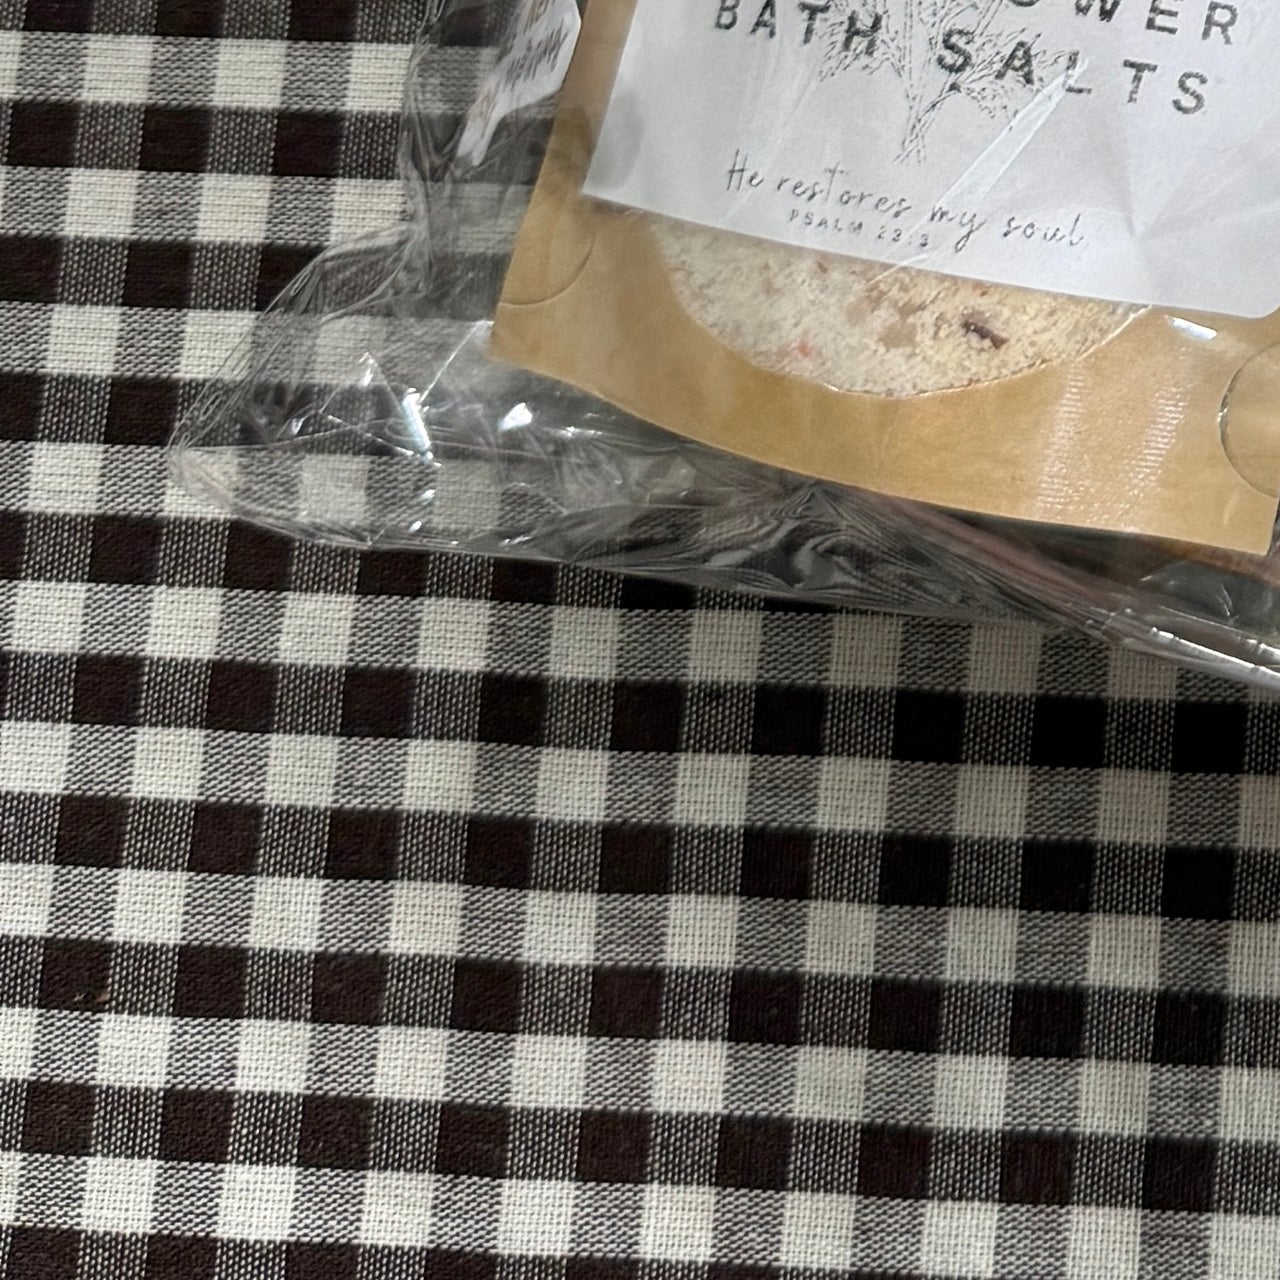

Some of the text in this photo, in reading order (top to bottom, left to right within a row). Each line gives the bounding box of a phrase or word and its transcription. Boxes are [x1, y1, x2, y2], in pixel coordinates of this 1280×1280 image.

[937, 29, 1210, 116] SALTS
[725, 148, 1086, 253] He restores my soul
[788, 207, 863, 234] PSALM
